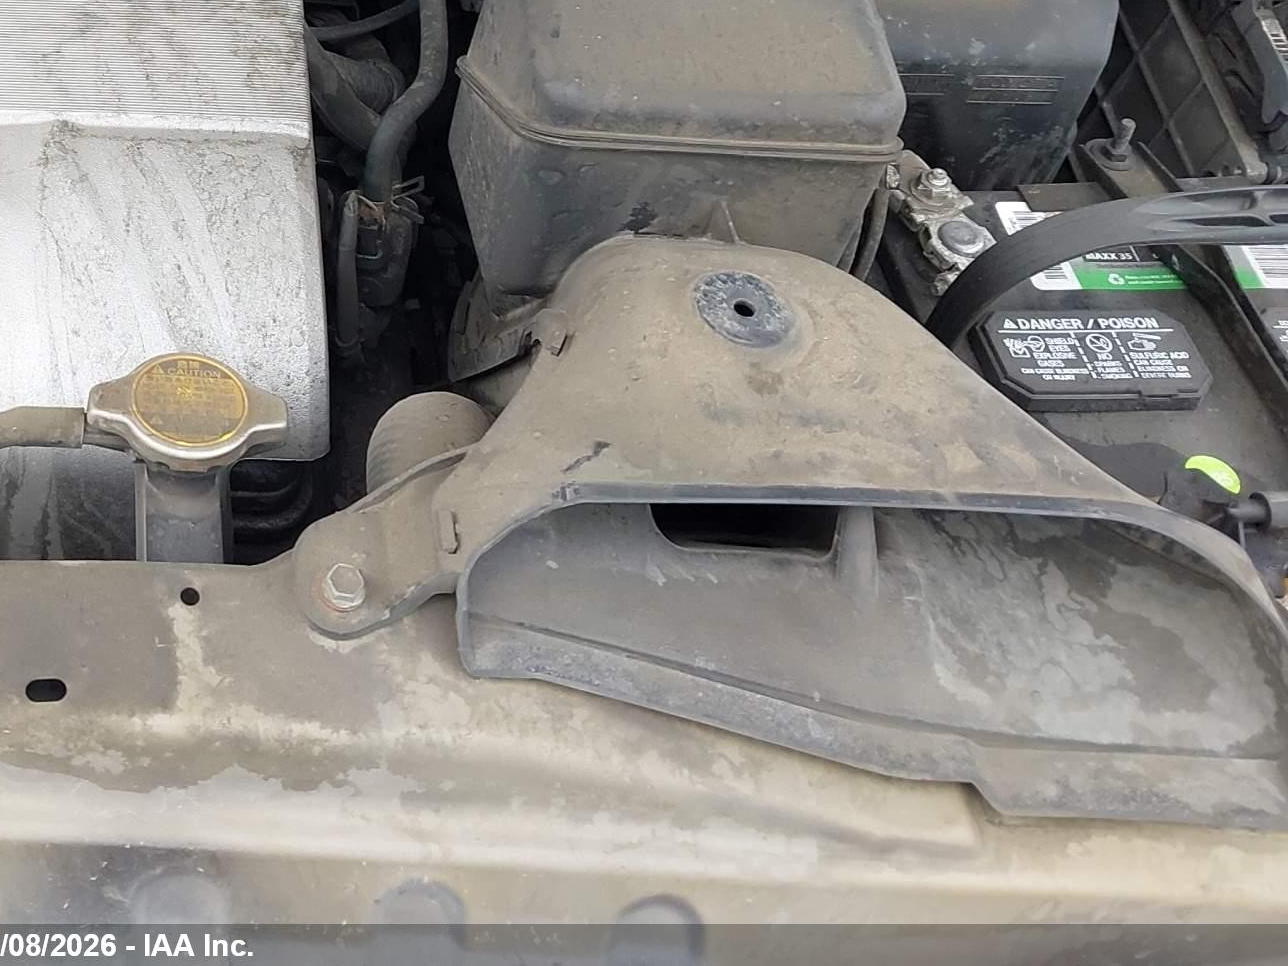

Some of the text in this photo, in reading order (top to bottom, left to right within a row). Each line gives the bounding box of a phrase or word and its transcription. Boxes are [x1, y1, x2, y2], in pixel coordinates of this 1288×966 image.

[1016, 318, 1085, 330] DANGER
[1097, 317, 1160, 329] POISON
[167, 367, 221, 379] CAUTION
